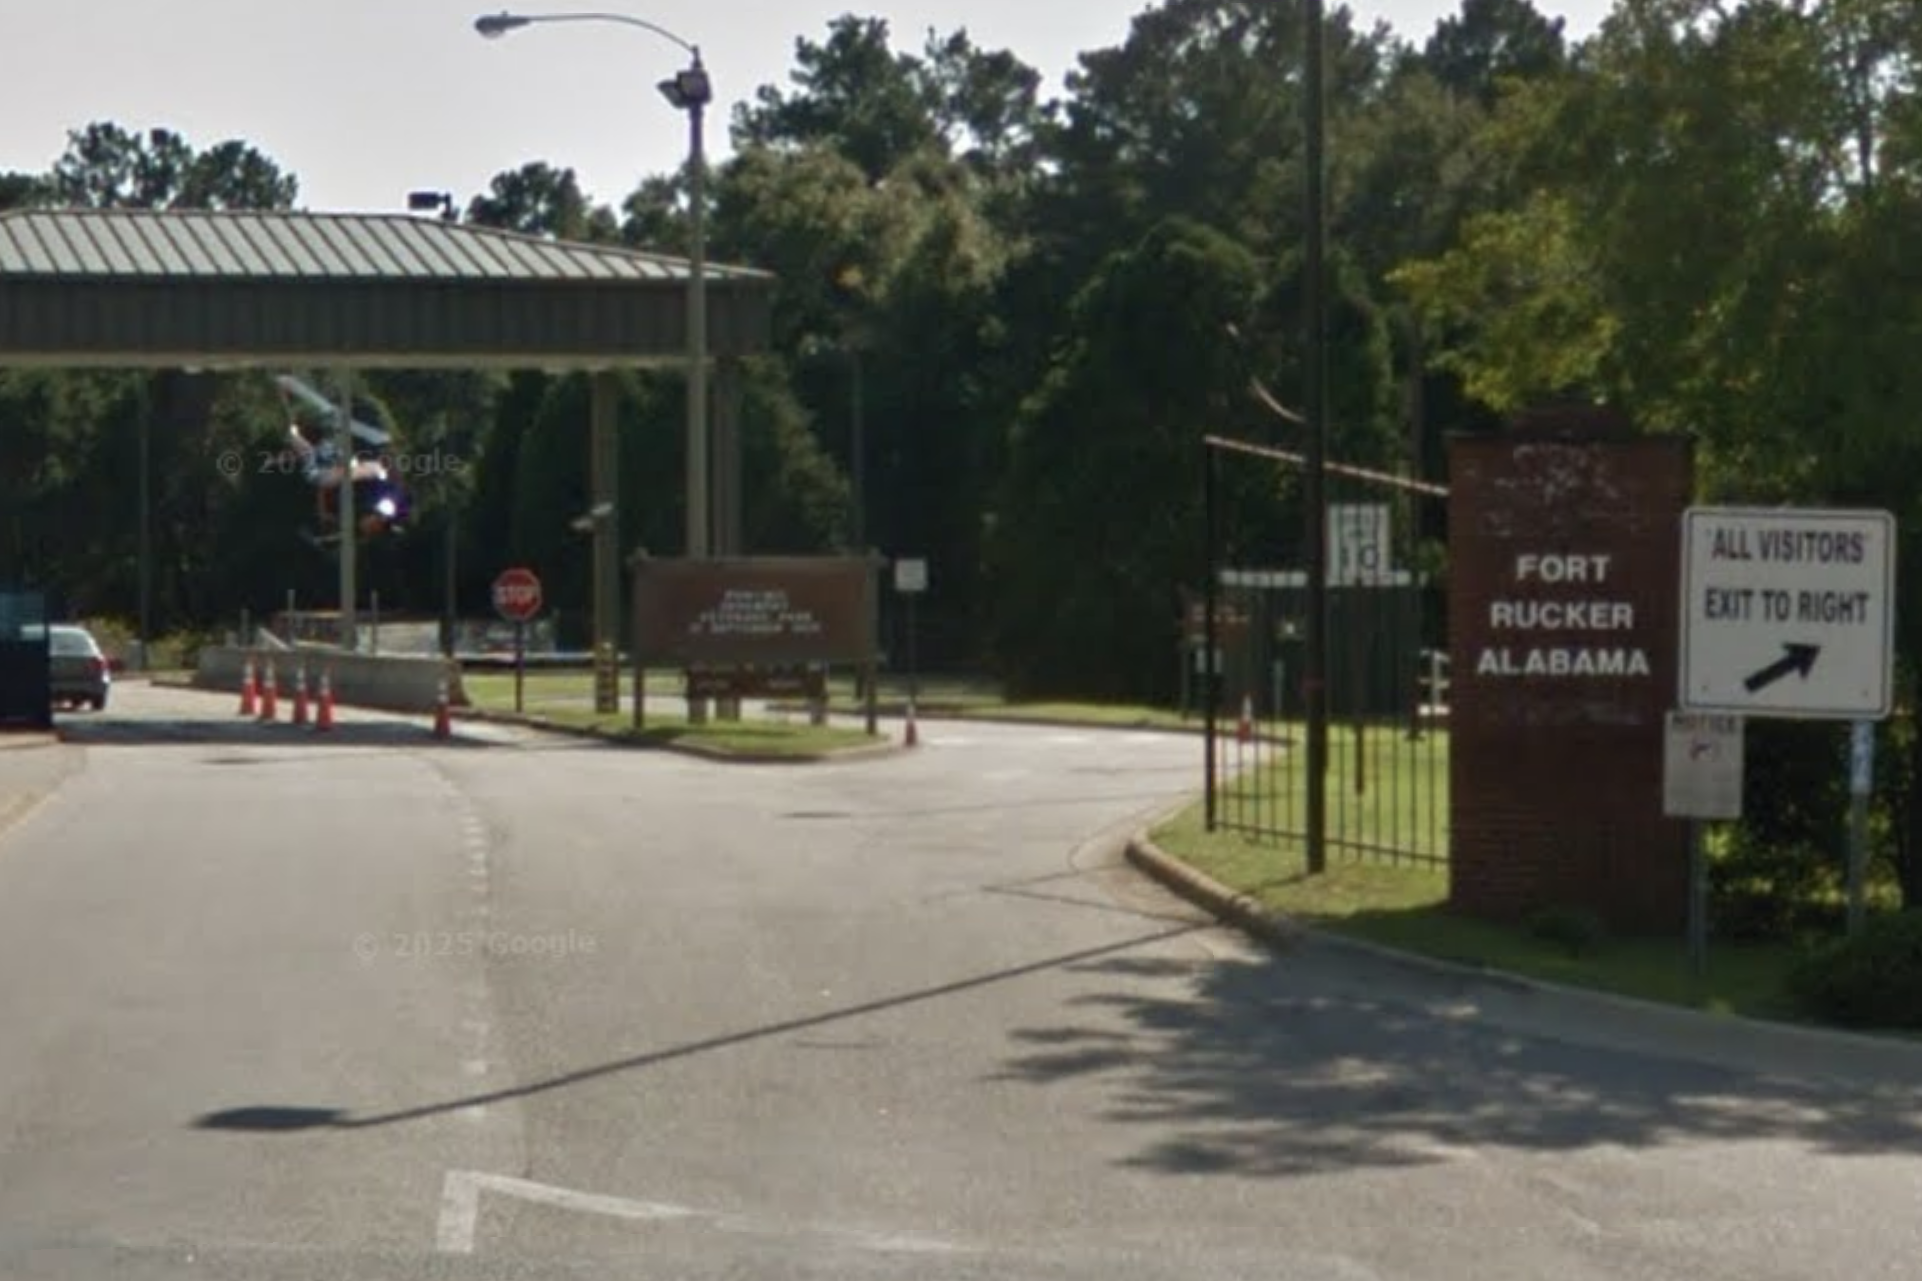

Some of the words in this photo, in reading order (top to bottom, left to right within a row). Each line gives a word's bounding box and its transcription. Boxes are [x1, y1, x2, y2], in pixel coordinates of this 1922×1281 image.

[1712, 528, 1753, 560] ALL
[1759, 530, 1865, 564] VISITORS
[1516, 553, 1611, 582] FORT
[494, 585, 537, 605] STOP
[1705, 588, 1754, 621] EXIT
[1761, 590, 1791, 621] TO
[1798, 590, 1869, 624] RIGHT
[1490, 601, 1634, 630] RUCKER
[1477, 648, 1650, 676] ALABAMA
